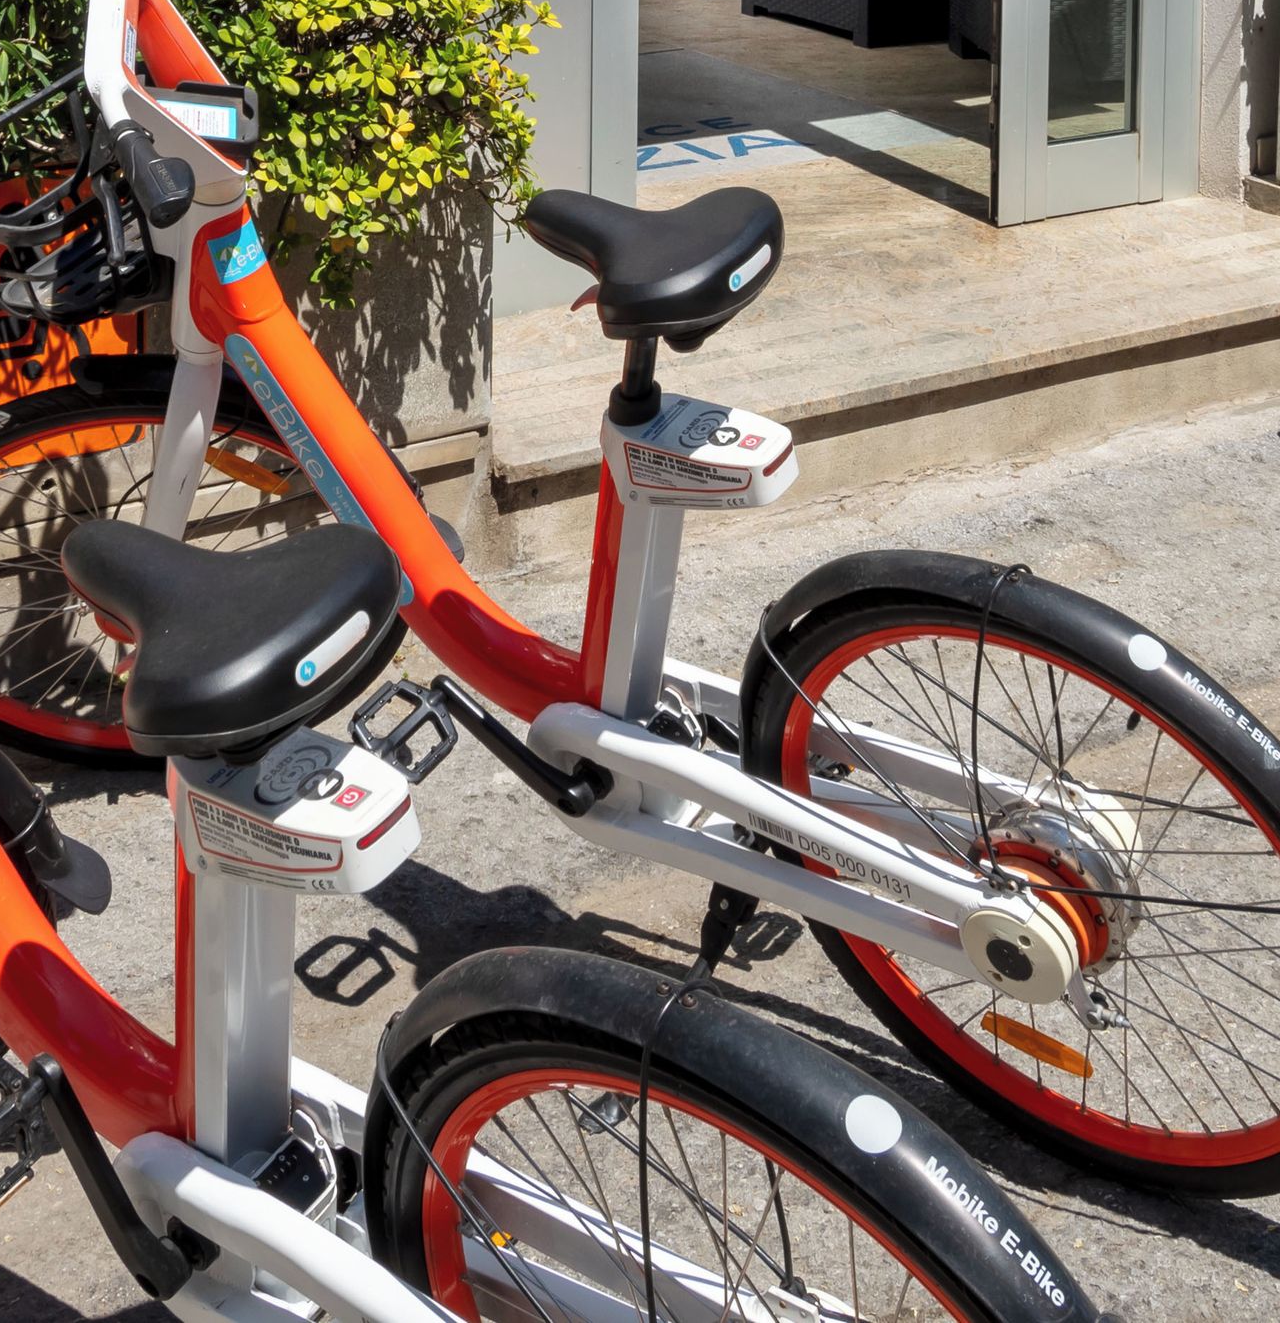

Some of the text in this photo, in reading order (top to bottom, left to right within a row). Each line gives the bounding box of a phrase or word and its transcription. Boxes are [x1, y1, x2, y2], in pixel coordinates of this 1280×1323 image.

[253, 380, 324, 479] e-Bike
[715, 429, 737, 444] 4
[1182, 670, 1236, 718] Mobike
[262, 756, 294, 783] CARD
[285, 844, 333, 862] PECUNIARIA
[798, 834, 912, 899] D05 000 0131
[923, 1155, 1066, 1307] Mobike E-Bike
